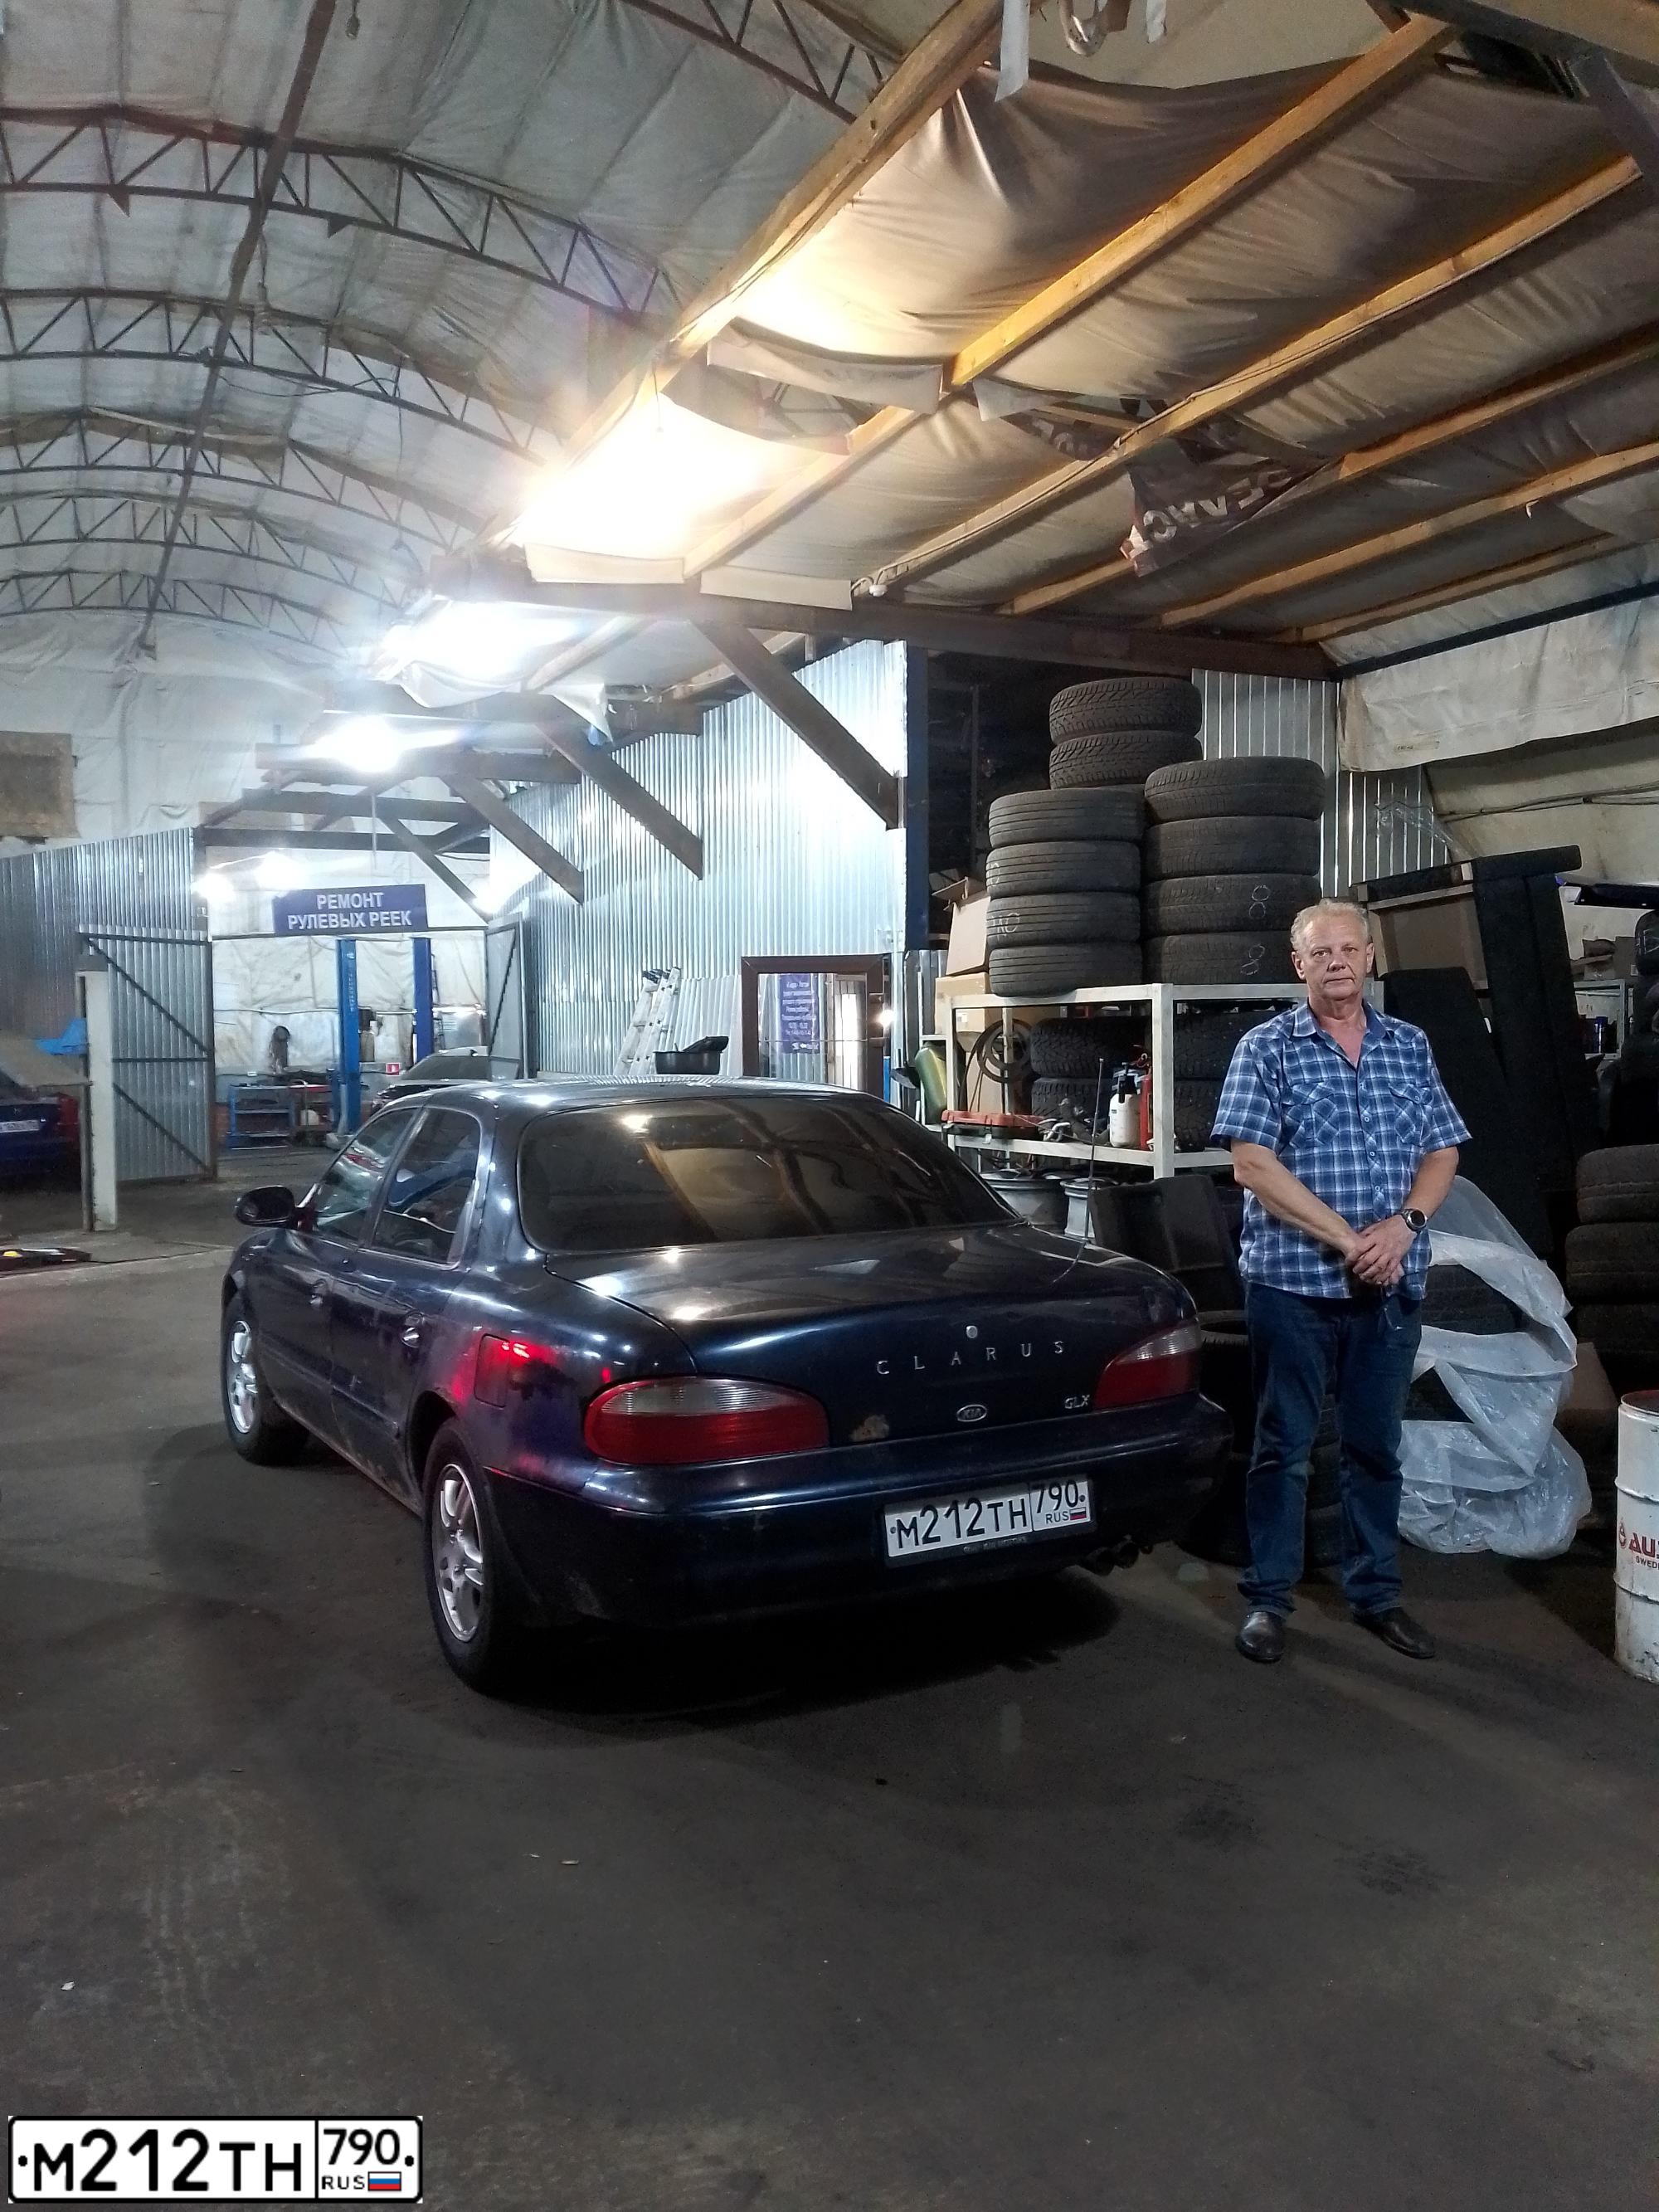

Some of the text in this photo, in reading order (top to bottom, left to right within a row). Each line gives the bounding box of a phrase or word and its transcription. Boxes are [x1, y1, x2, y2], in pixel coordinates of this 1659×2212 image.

[316, 892, 386, 910] РЕМОНТ
[287, 910, 413, 930] РУЛЕВЫХ РЕЕК
[877, 1341, 1063, 1375] CLARUS
[1064, 1395, 1090, 1409] GLX
[1034, 1480, 1079, 1514] 790
[1045, 1511, 1069, 1524] RUS
[1628, 1532, 1659, 1559] AU
[1635, 1555, 1659, 1570] SWED
